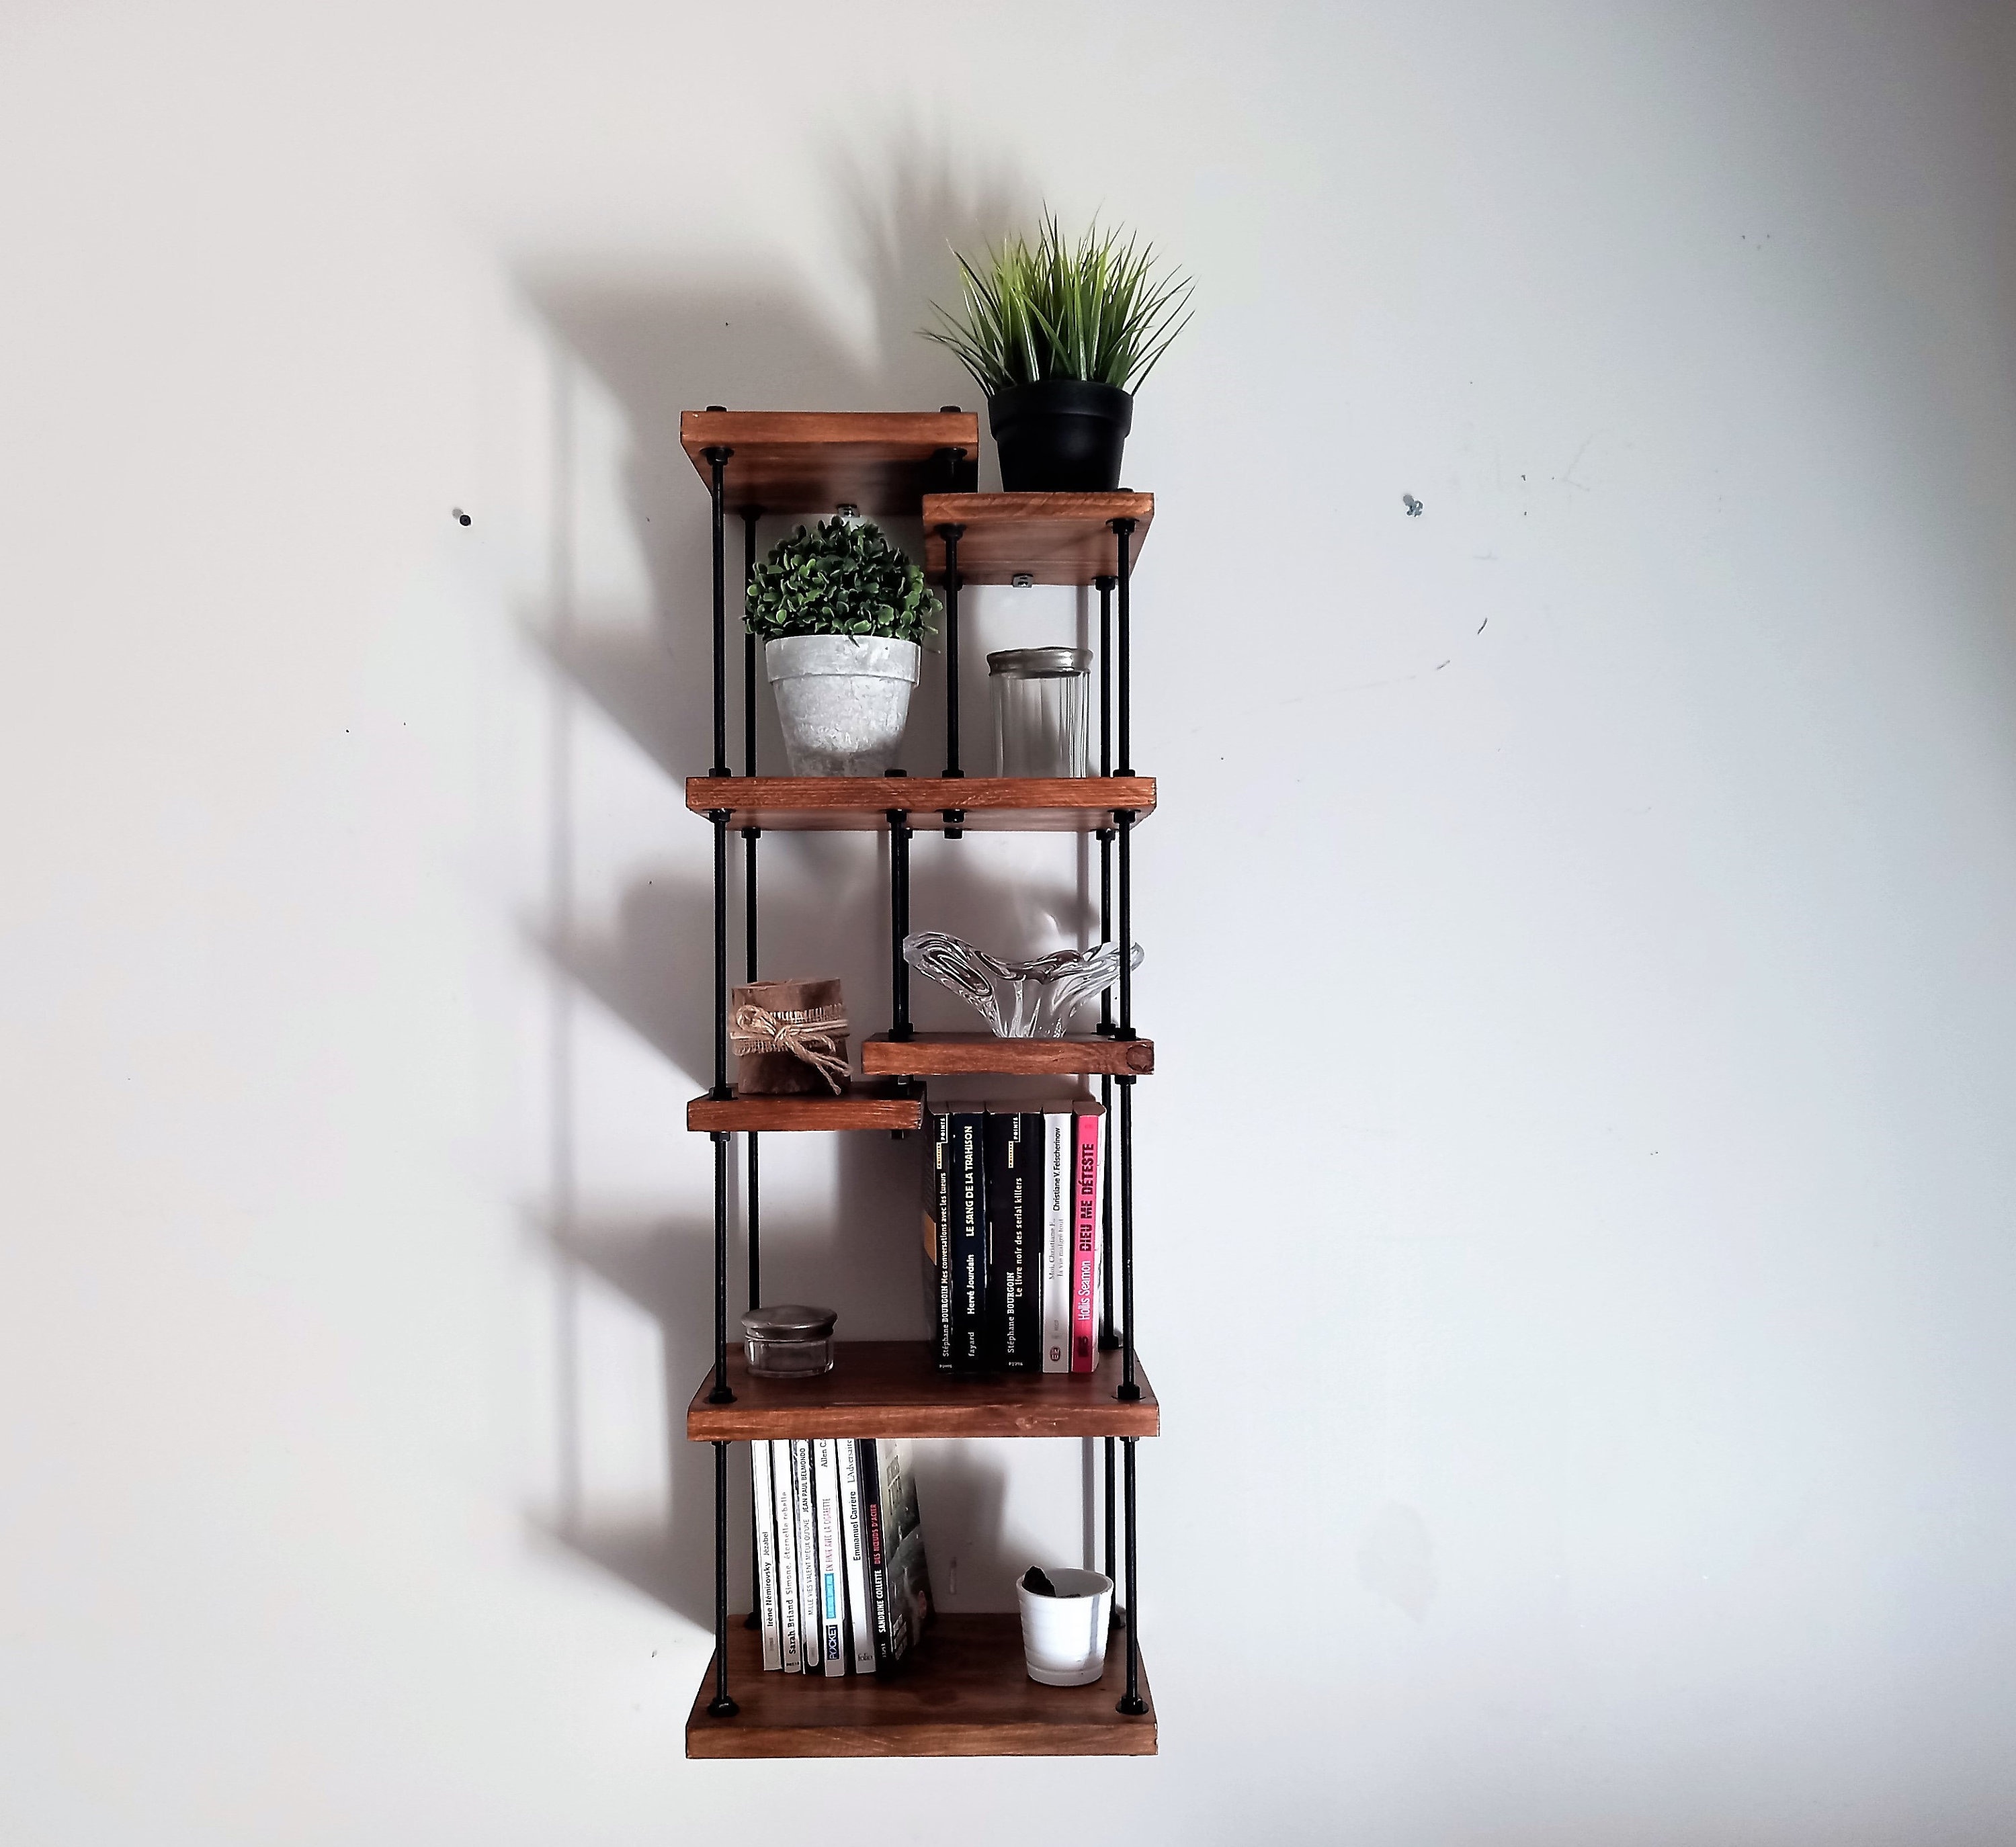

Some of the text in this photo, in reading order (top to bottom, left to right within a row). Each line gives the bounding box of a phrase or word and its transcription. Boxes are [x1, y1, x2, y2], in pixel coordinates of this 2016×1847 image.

[964, 1126, 974, 1236] LE SANG DE LA TRAHISON
[1013, 1178, 1022, 1203] killers
[1078, 1144, 1094, 1251] DIEU ME DÉTESTE
[1014, 1206, 1022, 1228] serial
[1014, 1231, 1022, 1244] des
[966, 1254, 975, 1314] Hervé Jourdain
[1007, 1272, 1015, 1314] BOURGOIN
[1015, 1288, 1022, 1297] Le
[1078, 1260, 1091, 1296] Seamon
[1077, 1298, 1091, 1320] Hollis
[942, 1324, 950, 1357] Stéphane
[968, 1332, 976, 1357] fayard
[1007, 1316, 1016, 1353] Stéphane
[782, 1523, 791, 1559] éternelle
[824, 1535, 833, 1547] AVEC
[848, 1492, 861, 1561] Emmanuel Carrère
[763, 1562, 773, 1627] Irène Némirovsky
[874, 1570, 884, 1599] COLLETTE
[786, 1599, 794, 1627] Briand
[876, 1600, 886, 1633] SANDRINE
[788, 1630, 796, 1654] Sarah
[828, 1625, 837, 1660] POCKET
